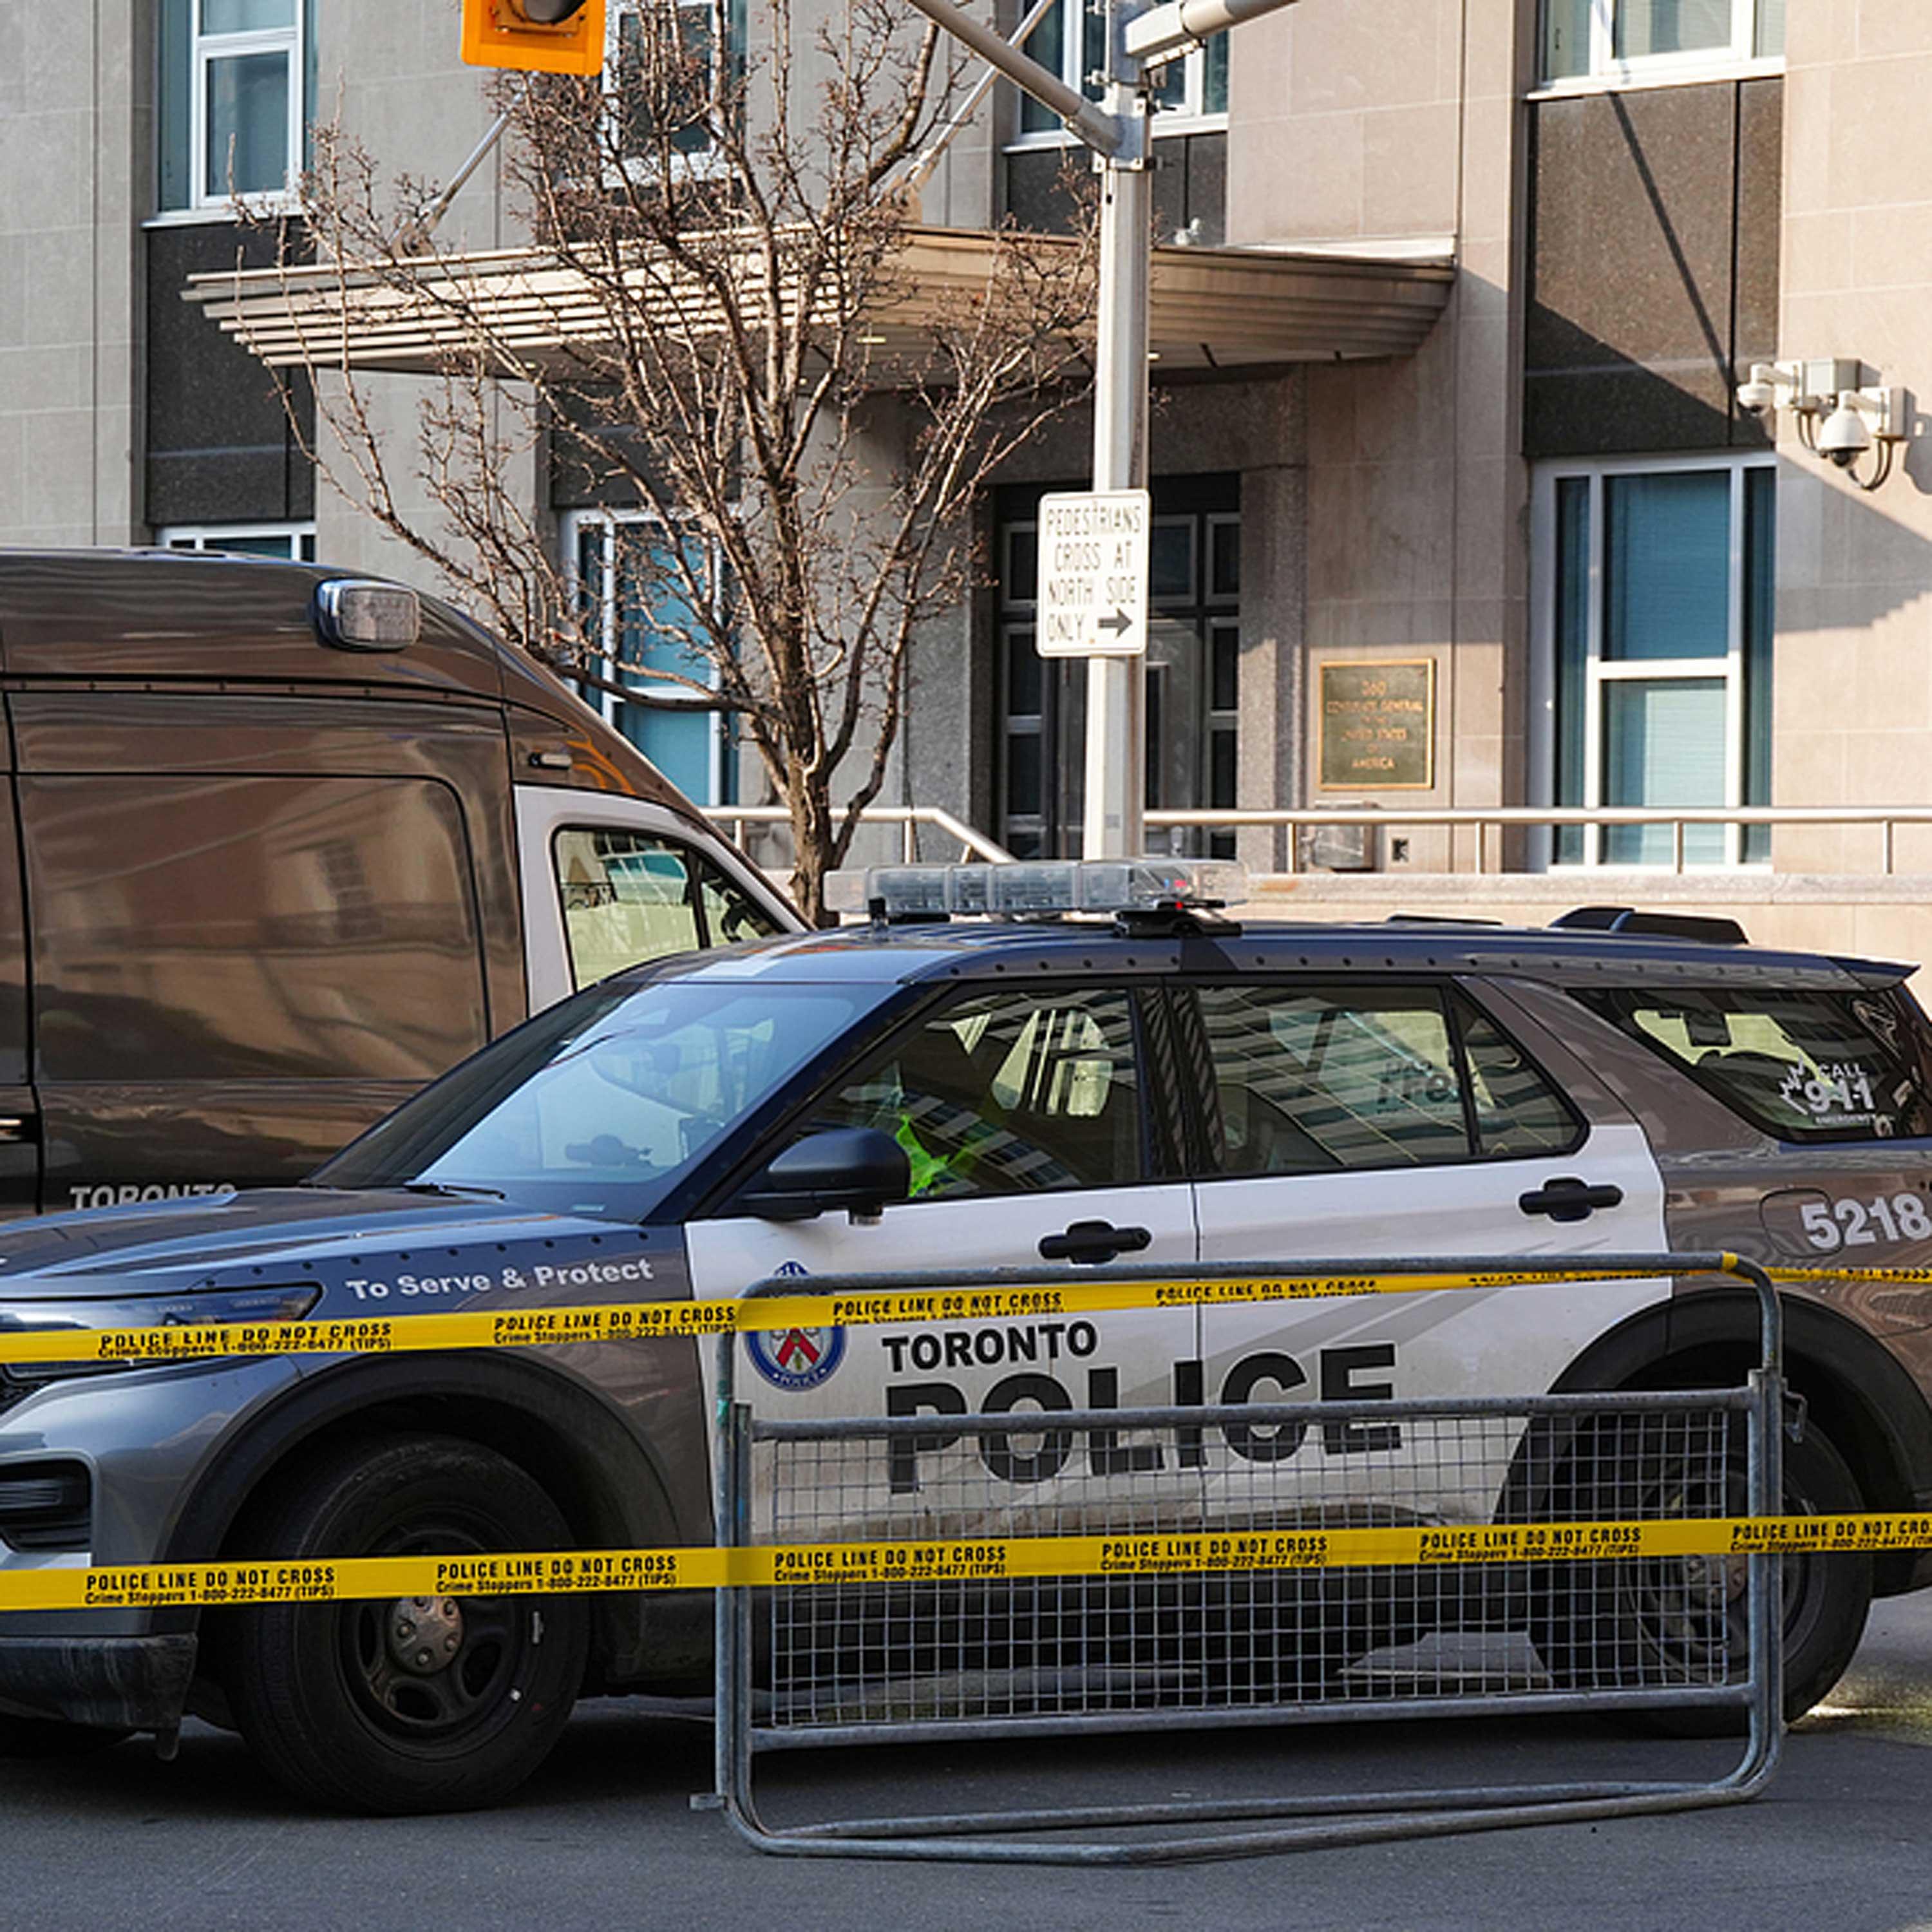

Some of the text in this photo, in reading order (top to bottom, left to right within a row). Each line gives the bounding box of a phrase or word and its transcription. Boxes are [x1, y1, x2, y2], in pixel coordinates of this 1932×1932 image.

[1046, 506, 1141, 536] PEDESTRIANS
[1055, 540, 1132, 572] CROSS AT
[1048, 576, 1136, 607] NORTH SIDE
[1047, 612, 1085, 641] ONLY
[1818, 1063, 1868, 1079] CALL
[1800, 1193, 1932, 1249] 5218
[346, 1258, 654, 1300] To Serve & Protect
[834, 1292, 1061, 1316] POLICE LINE DO NOT CROSS
[495, 1306, 735, 1330] POLICE LINE DO NOT CROSS
[102, 1323, 392, 1349] POLICE LINE DO NOT CROSS
[882, 1320, 1098, 1372] TORONTO
[99, 1346, 141, 1358] Crime
[886, 1343, 1401, 1495] POLICE
[1421, 1528, 1641, 1548] POLICE LINE DO NOT CROSS
[1734, 1524, 1786, 1539] POLICE
[1795, 1522, 1827, 1537] LINE
[1836, 1522, 1856, 1536] DO
[1864, 1521, 1892, 1535] NOT
[775, 1546, 1006, 1567] POLICE LINE DO NOT CROSS
[1102, 1537, 1327, 1557] POLICE LINE DO NOT CROSS
[1419, 1549, 1452, 1561] Crime
[438, 1556, 677, 1578] POLICE LINE DO NOT CROSS
[775, 1569, 810, 1581] Crime
[969, 1564, 1005, 1576] (TIPS)
[1101, 1558, 1135, 1571] Crime
[87, 1567, 334, 1589] POLICE LINE DO NOT CROSS
[437, 1579, 473, 1593] Crime
[638, 1574, 676, 1587] (TIPS)
[85, 1591, 122, 1604] Crime
[127, 1589, 184, 1604] Stoppers
[295, 1586, 334, 1599] (TIPS)
